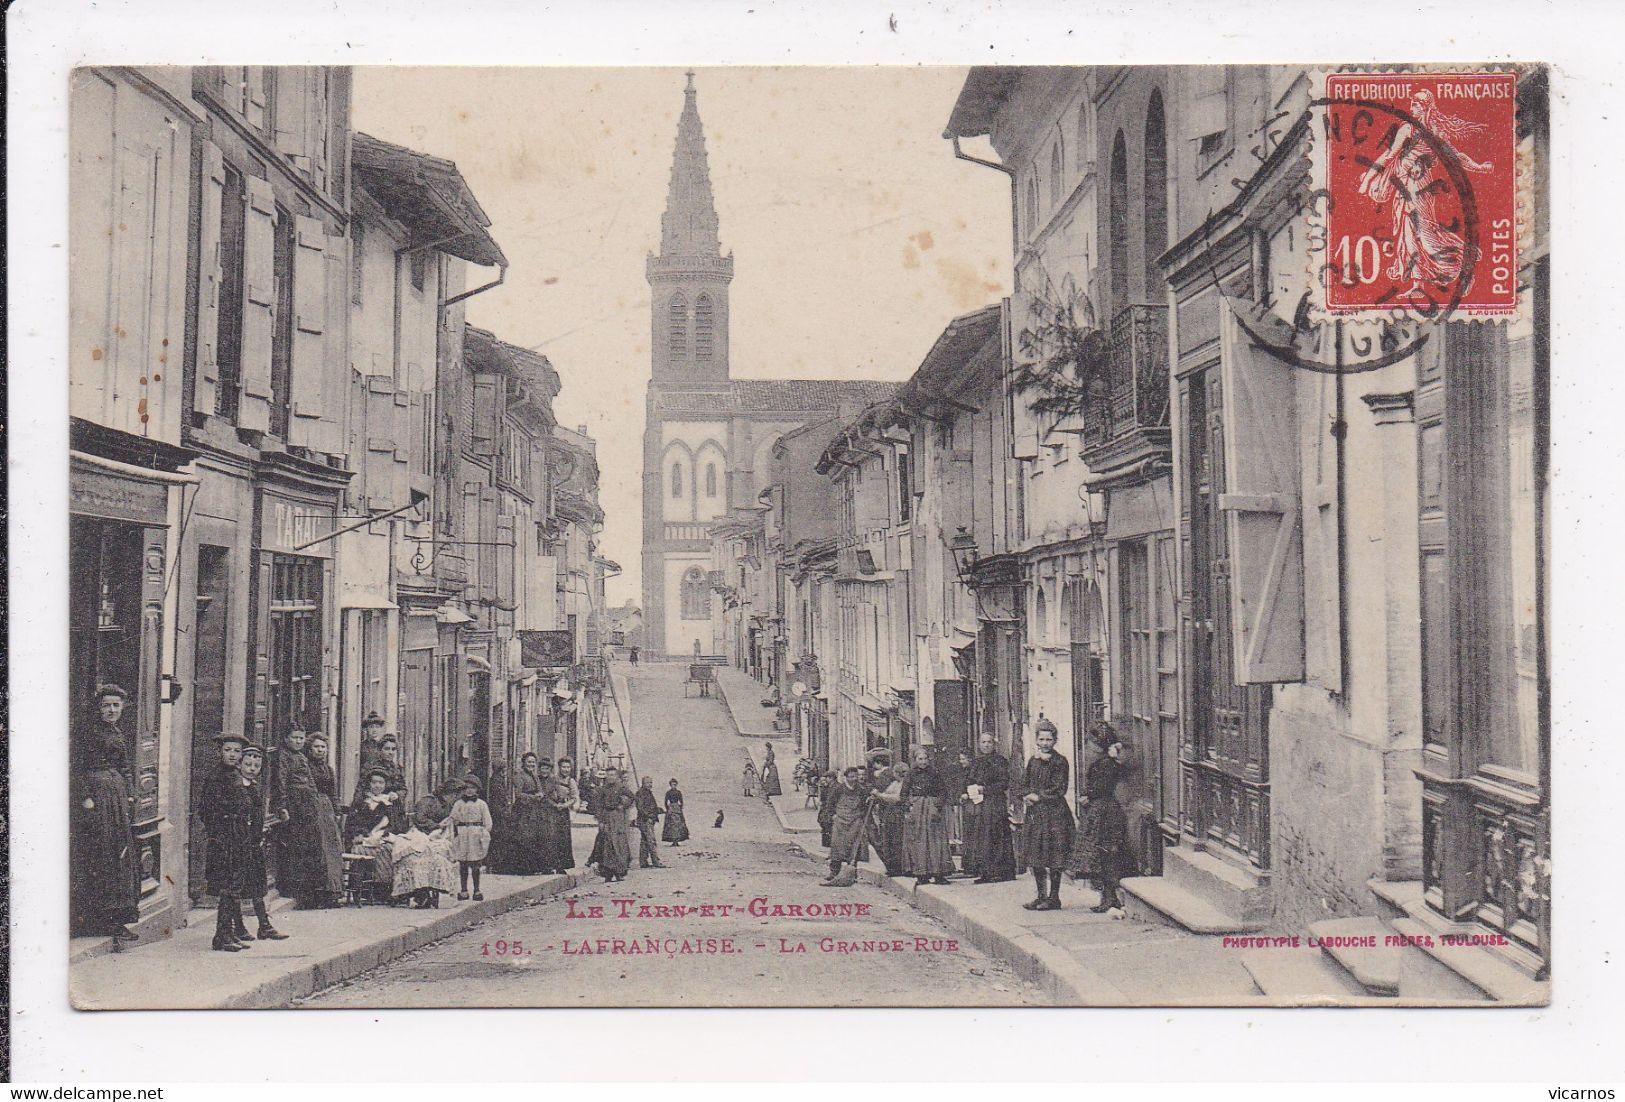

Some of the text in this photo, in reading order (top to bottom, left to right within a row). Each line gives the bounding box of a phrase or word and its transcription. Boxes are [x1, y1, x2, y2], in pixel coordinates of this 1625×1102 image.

[1334, 82, 1511, 103] REPUBLIQUE FRANÇAISE
[1492, 218, 1510, 294] POSTES
[481, 940, 532, 956] 195.
[563, 938, 743, 959] LAFRANÇAISE.
[1222, 936, 1301, 948] PHOTOTYPIE
[1308, 936, 1377, 948] LABOUCHE
[1439, 933, 1509, 947] TOULOUSE.
